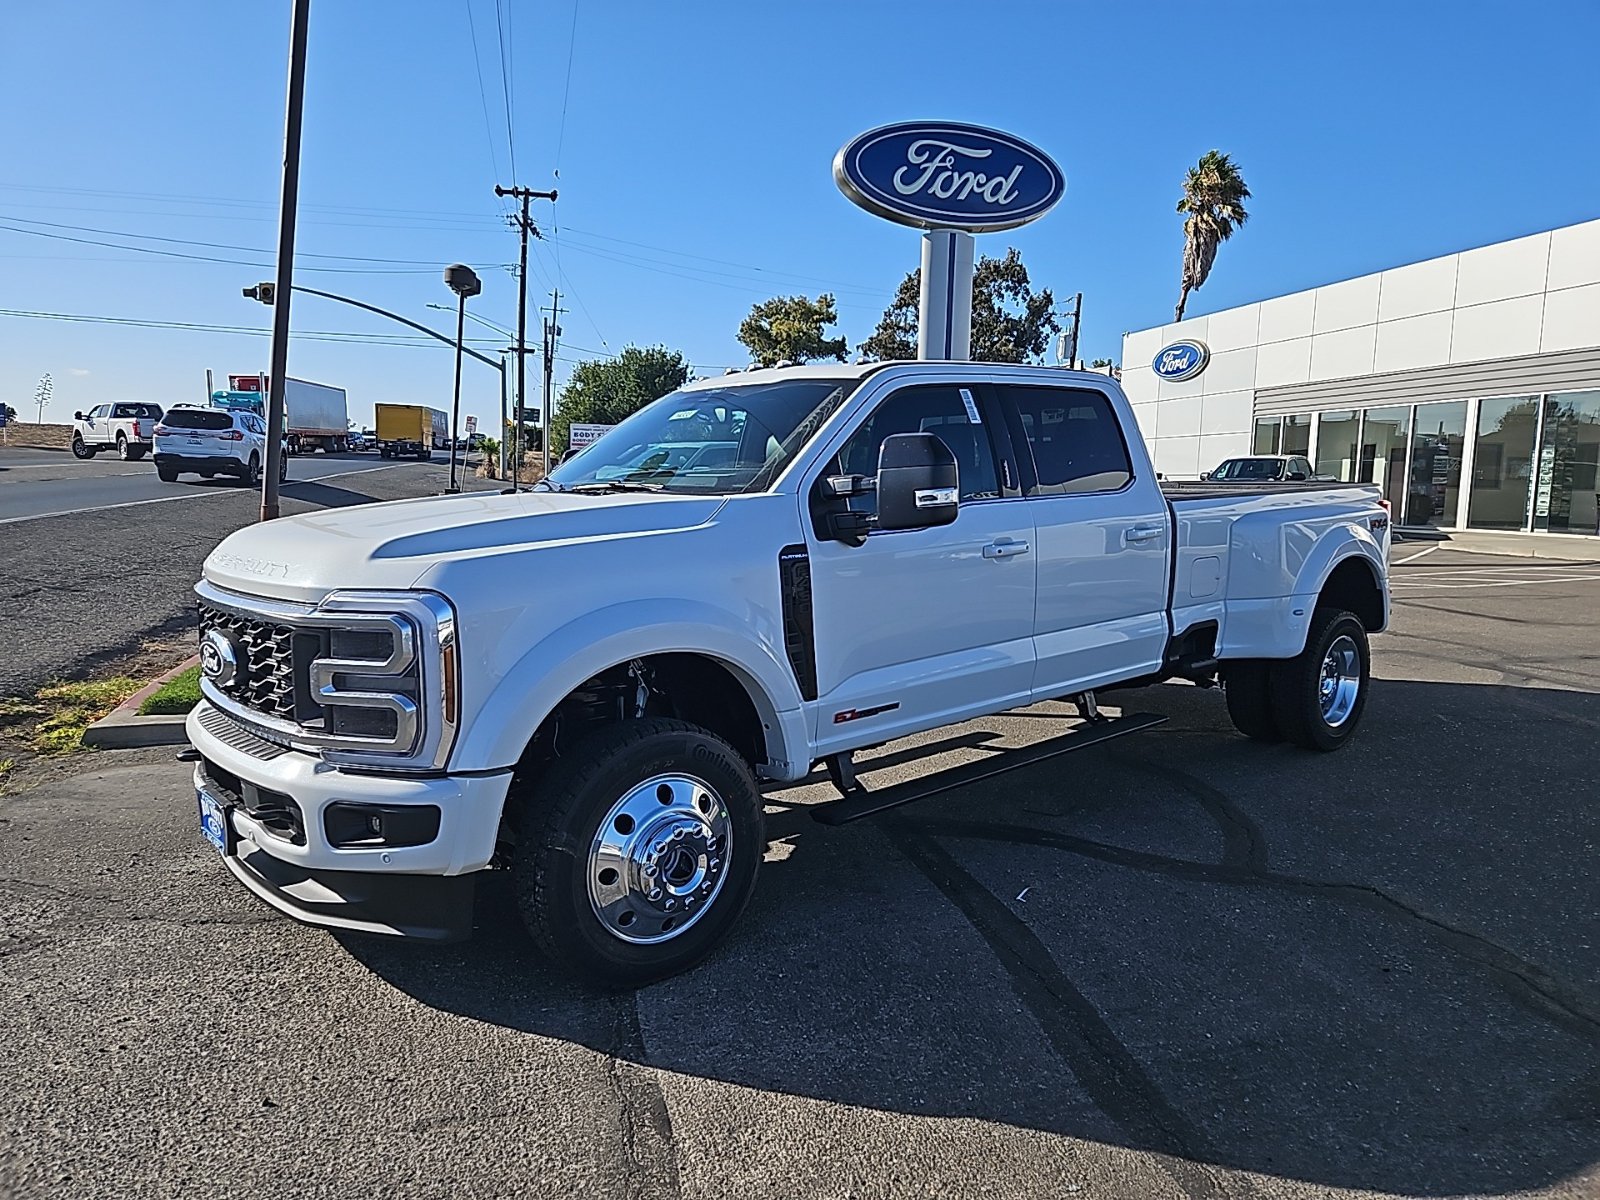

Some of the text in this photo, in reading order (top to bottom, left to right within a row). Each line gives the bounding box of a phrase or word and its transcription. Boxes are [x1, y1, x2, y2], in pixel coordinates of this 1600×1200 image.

[893, 139, 1024, 205] Ford
[1159, 348, 1191, 374] Ford
[202, 644, 219, 672] Ford
